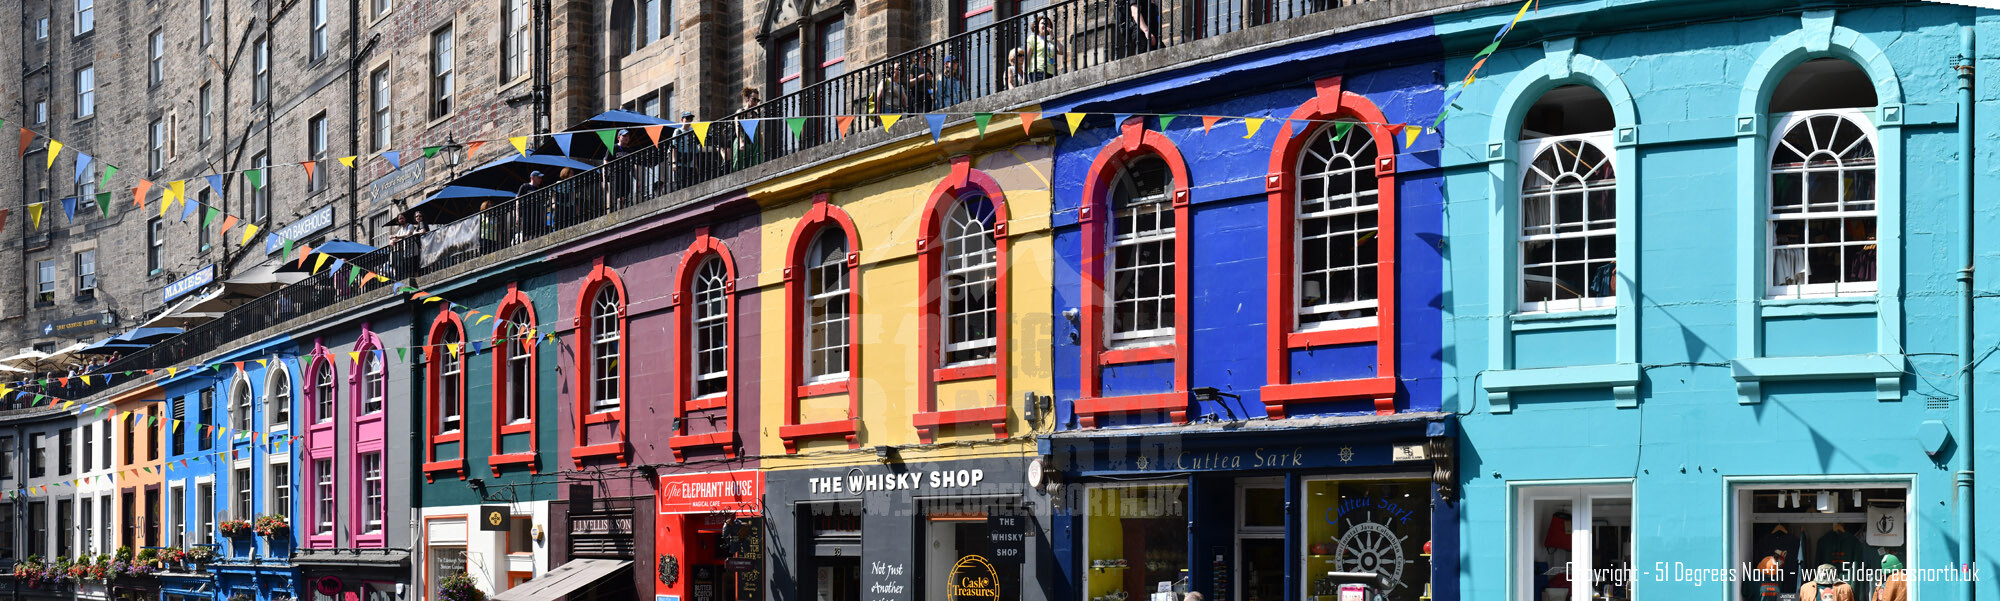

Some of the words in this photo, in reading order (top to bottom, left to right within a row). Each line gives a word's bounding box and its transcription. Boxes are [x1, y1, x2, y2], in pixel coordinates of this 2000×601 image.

[293, 208, 331, 239] BAKEHOUSE
[165, 273, 202, 299] MAXIES
[1177, 450, 1241, 471] Cuttea
[1253, 447, 1304, 468] Sark
[809, 476, 842, 493] THE
[848, 471, 923, 493] WHISKY
[929, 469, 984, 489] SHOP
[664, 480, 684, 501] The
[682, 481, 724, 498] ELEPHANT
[725, 480, 753, 497] HOUSE
[1377, 496, 1414, 525] Sark
[616, 518, 632, 530] SON
[999, 518, 1015, 526] THE
[991, 533, 1023, 541] WHISKY
[871, 560, 886, 575] Not
[871, 581, 904, 594] Another
[962, 577, 985, 588] Cask
[952, 585, 995, 597] Treasures
